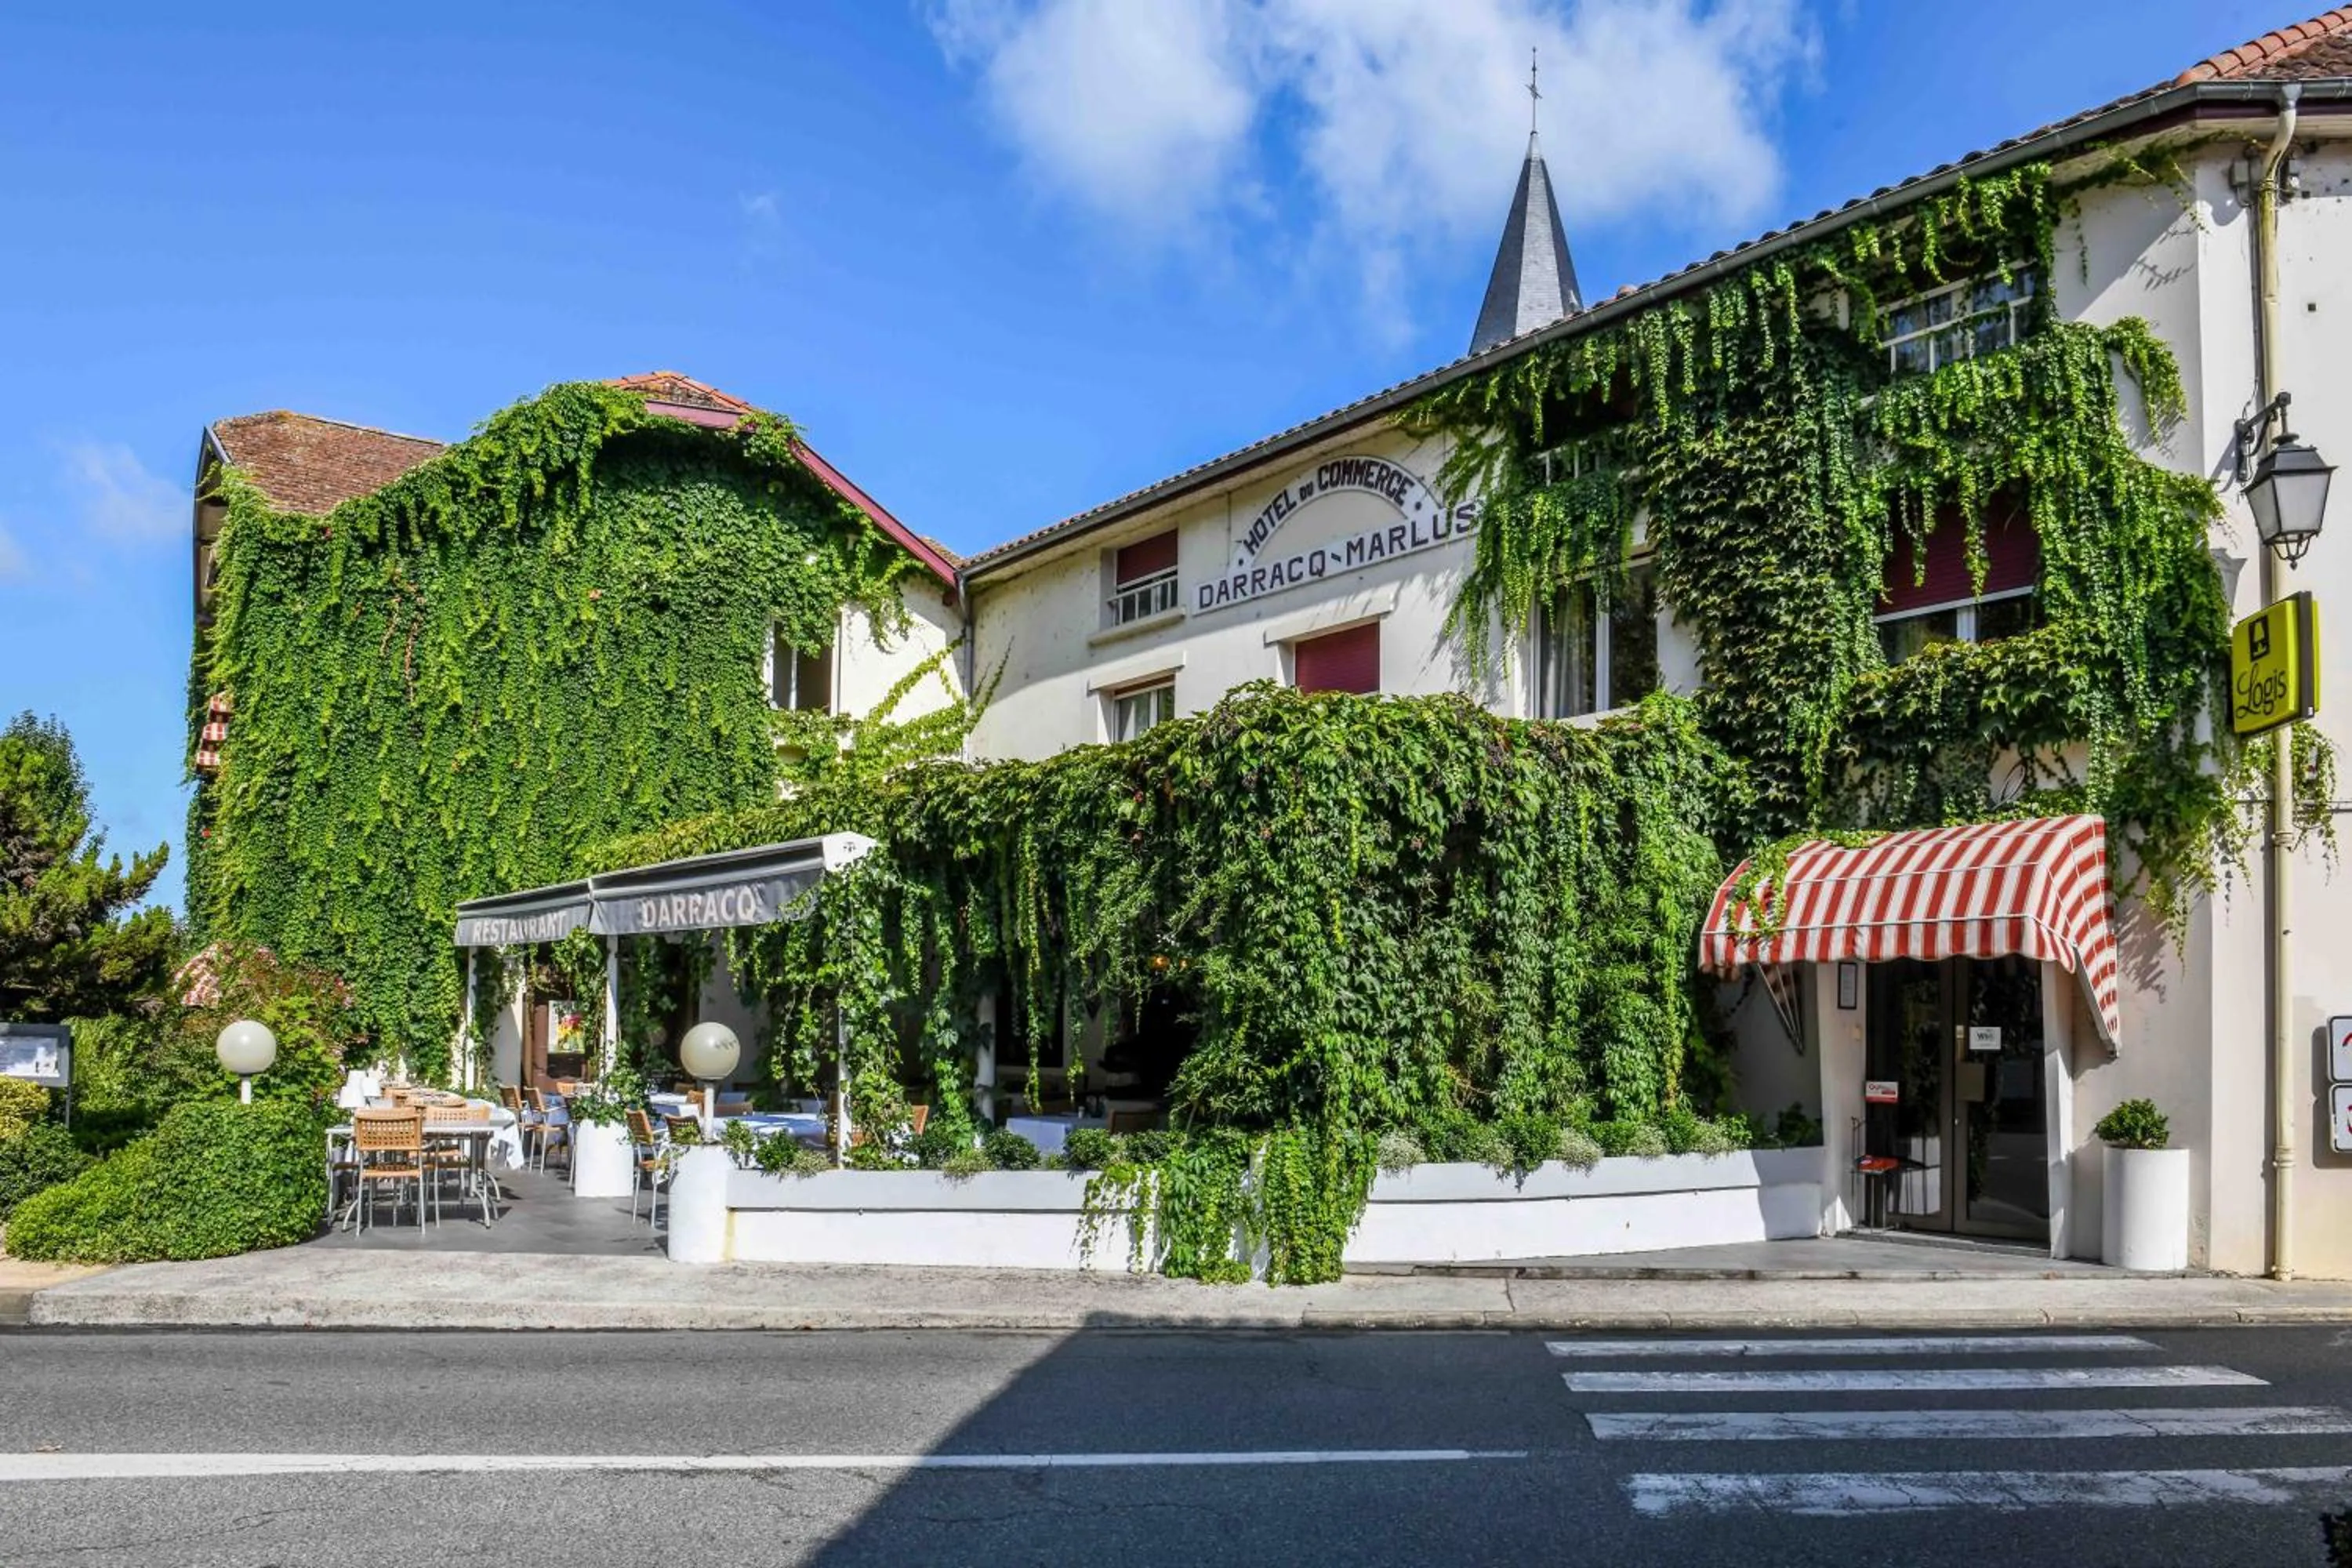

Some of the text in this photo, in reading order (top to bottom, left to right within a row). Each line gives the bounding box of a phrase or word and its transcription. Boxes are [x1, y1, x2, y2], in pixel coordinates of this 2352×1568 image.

[1243, 459, 1414, 556] HOTEL DU COMMERCE
[2236, 662, 2287, 719] Logis
[472, 909, 568, 942] RESTAURANT
[641, 886, 757, 927] DARRACQ
